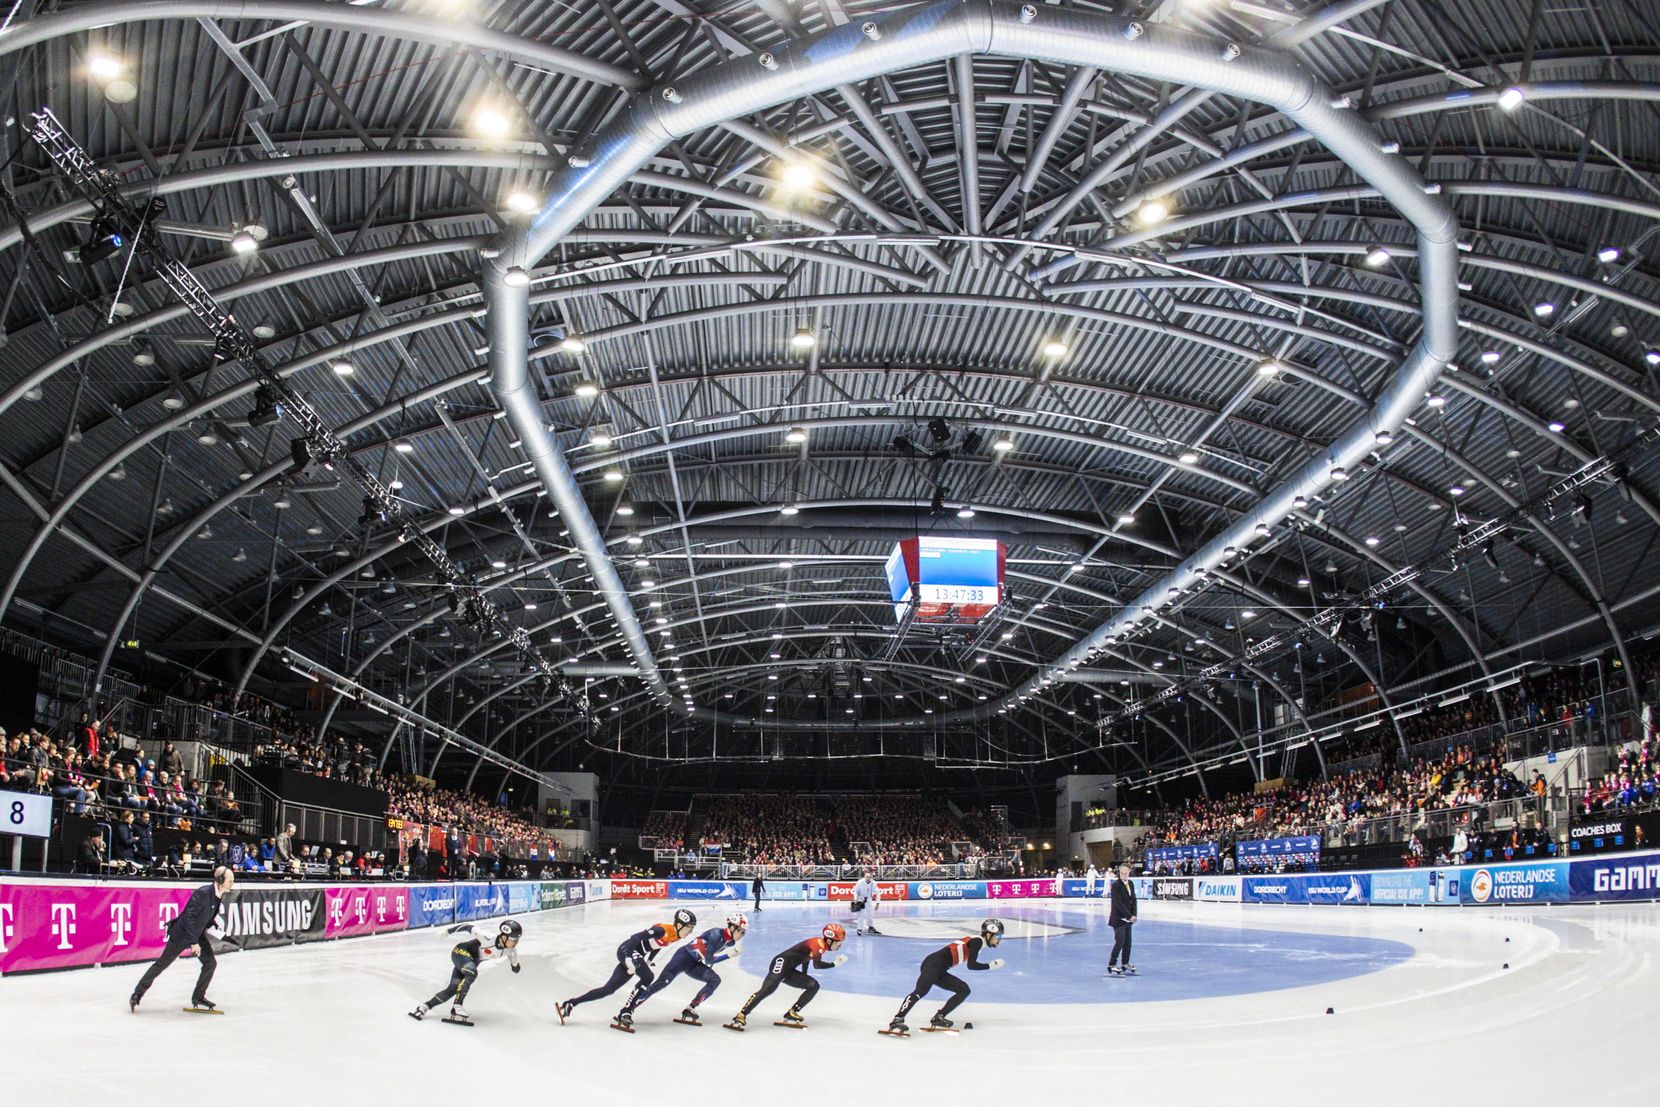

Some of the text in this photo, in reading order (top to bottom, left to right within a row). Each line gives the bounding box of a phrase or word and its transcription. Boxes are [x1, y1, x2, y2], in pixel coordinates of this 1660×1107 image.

[935, 588, 985, 601] 13:47:33
[10, 801, 25, 825] 8
[1571, 823, 1622, 838] COACHES BOX
[1494, 868, 1556, 883] NEDERLANDSE
[612, 884, 631, 894] Dordt
[632, 884, 655, 896] Sport
[934, 883, 977, 891] NEDERLANDSE
[1157, 882, 1189, 895] SAMSUNG
[1205, 883, 1237, 897] DAIKIN
[1493, 883, 1534, 899] LOTERIJ
[51, 903, 76, 950] T
[110, 903, 132, 946] T
